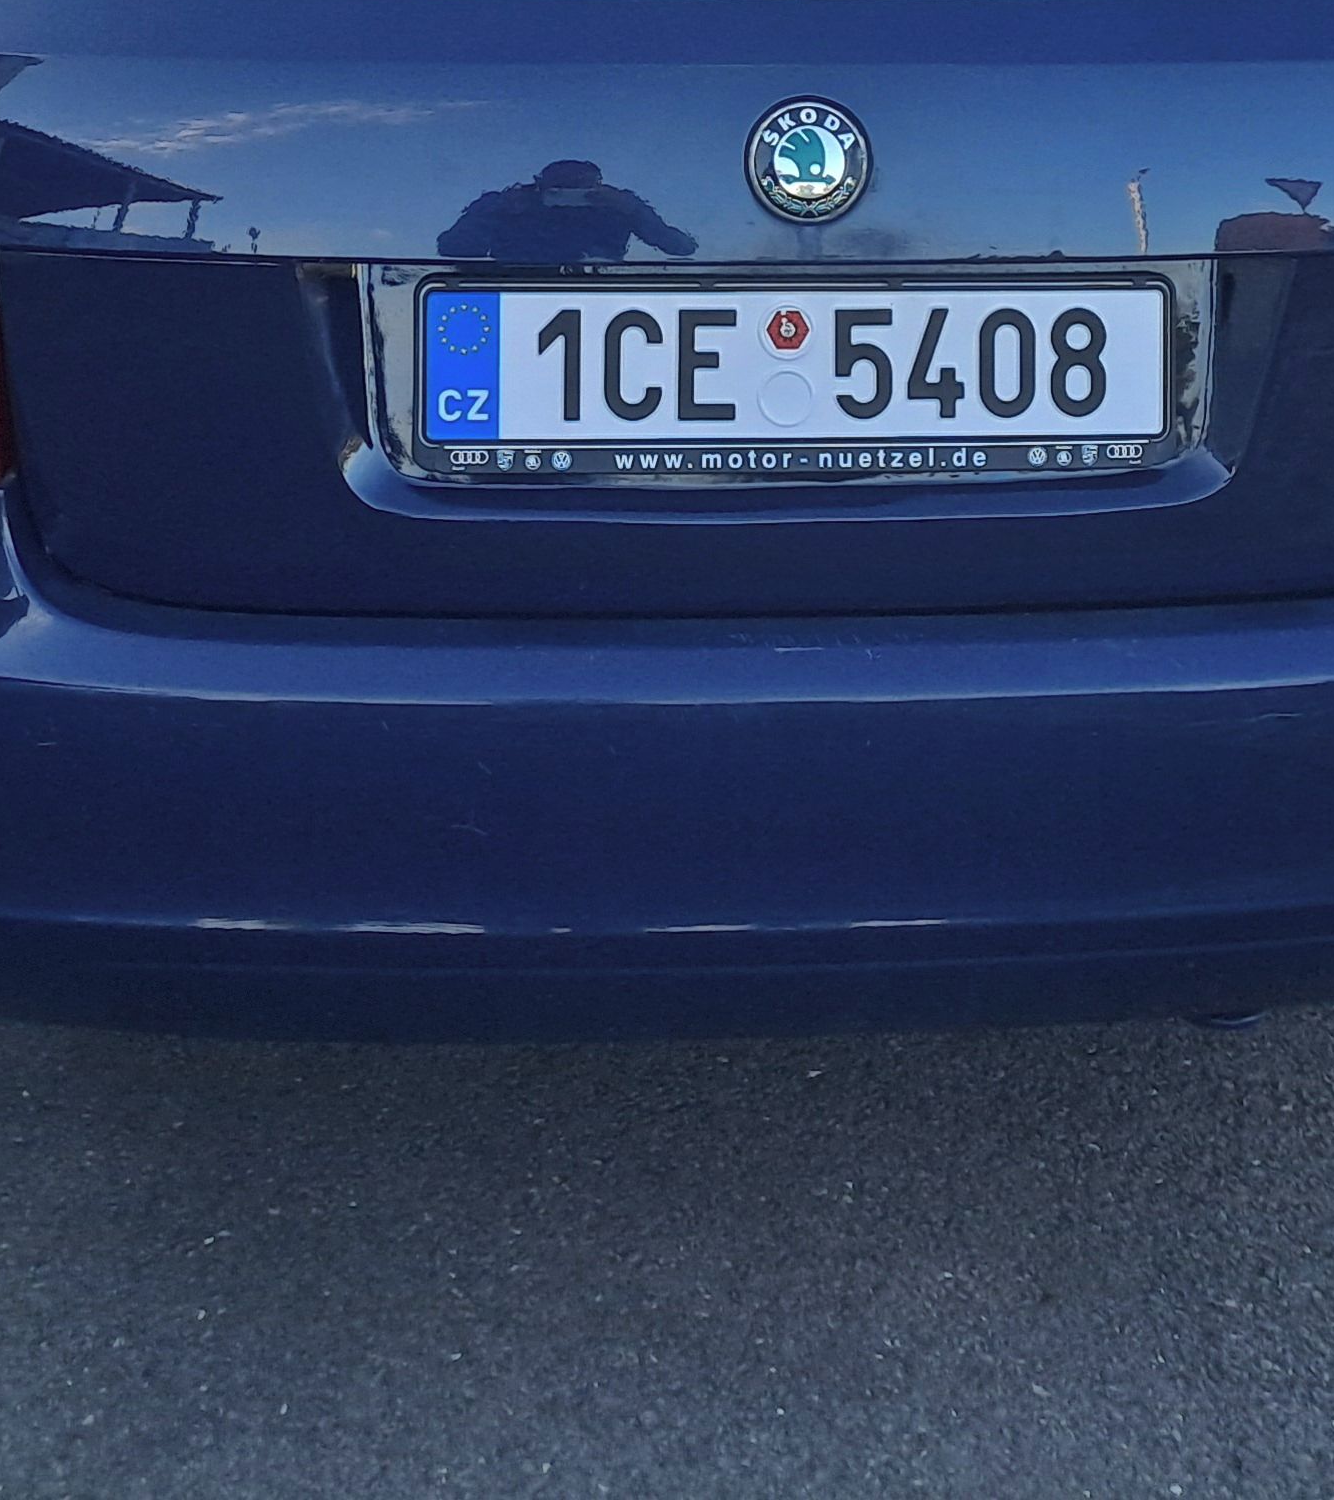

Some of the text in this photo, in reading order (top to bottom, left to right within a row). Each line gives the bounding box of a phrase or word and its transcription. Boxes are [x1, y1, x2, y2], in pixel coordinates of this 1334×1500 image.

[437, 307, 1108, 422] CZ 1CE 5408
